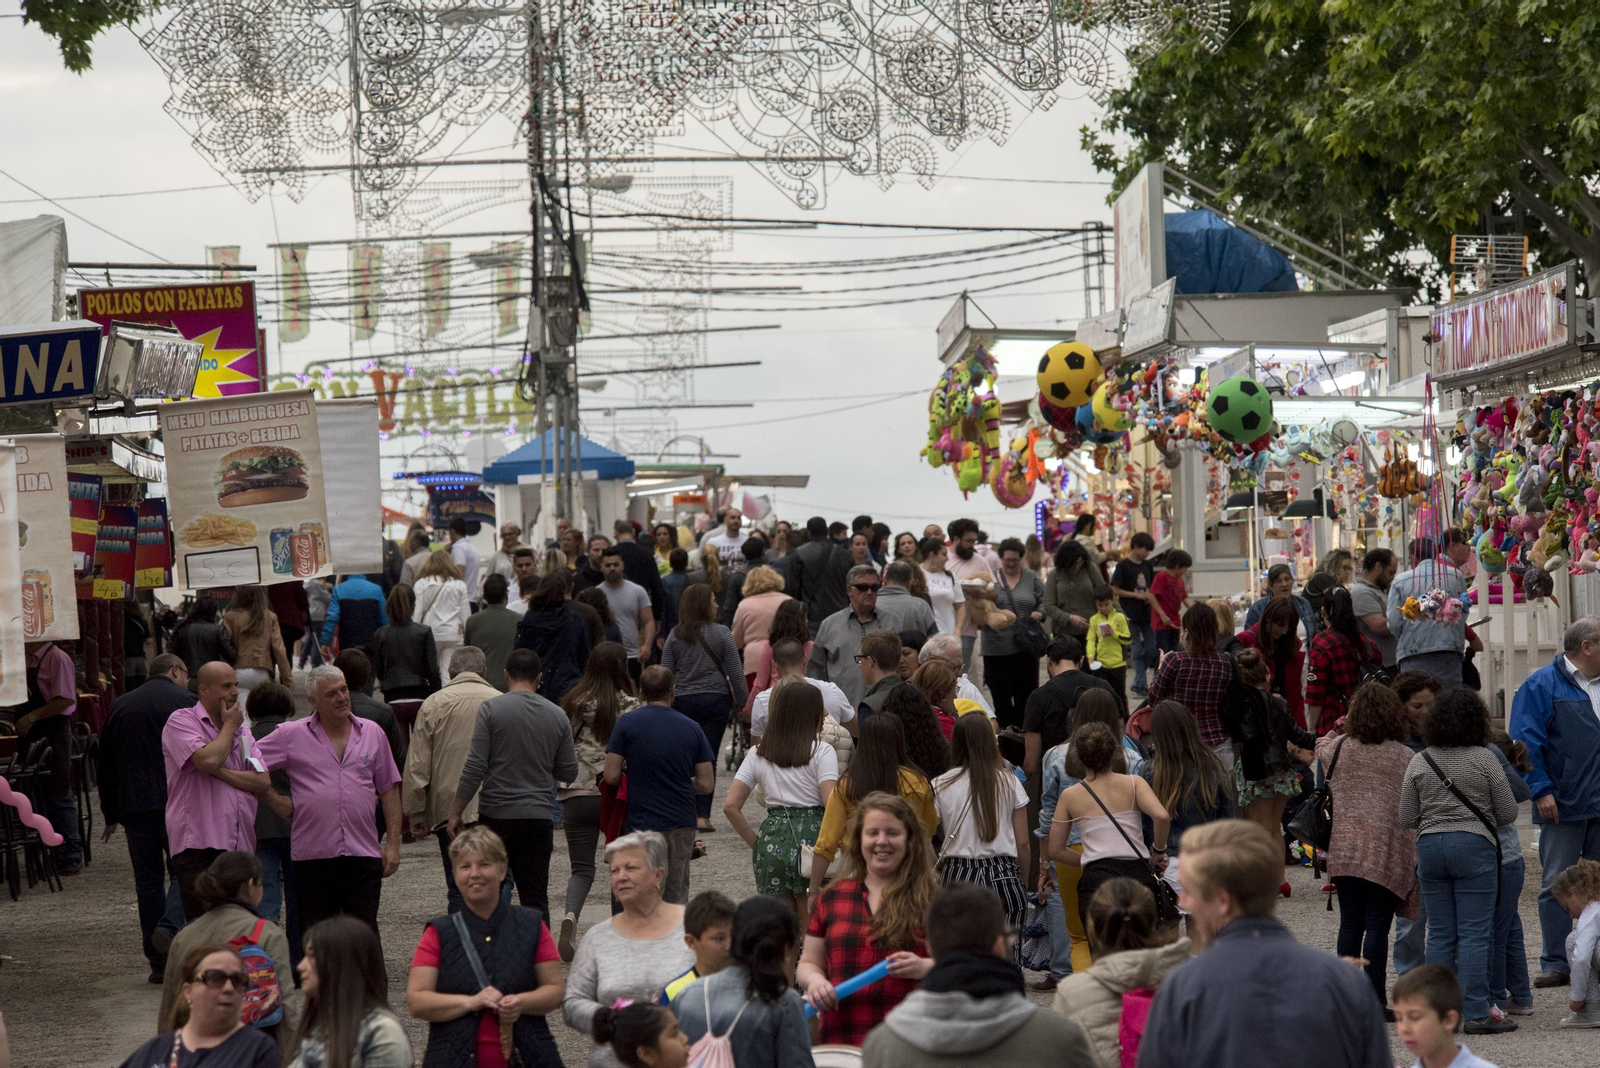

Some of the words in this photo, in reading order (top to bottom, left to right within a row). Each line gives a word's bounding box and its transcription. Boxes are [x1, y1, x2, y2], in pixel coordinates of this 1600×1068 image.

[86, 292, 142, 316] POLLOS
[144, 290, 175, 313] CON
[178, 286, 243, 311] PATATAS
[166, 412, 206, 431] MENU
[209, 400, 310, 426] HAMBURGUESA
[181, 431, 238, 452] PATATAS
[238, 432, 249, 443] +
[250, 424, 301, 444] BEBIDA
[200, 557, 216, 583] 5
[272, 540, 291, 570] Sprit
